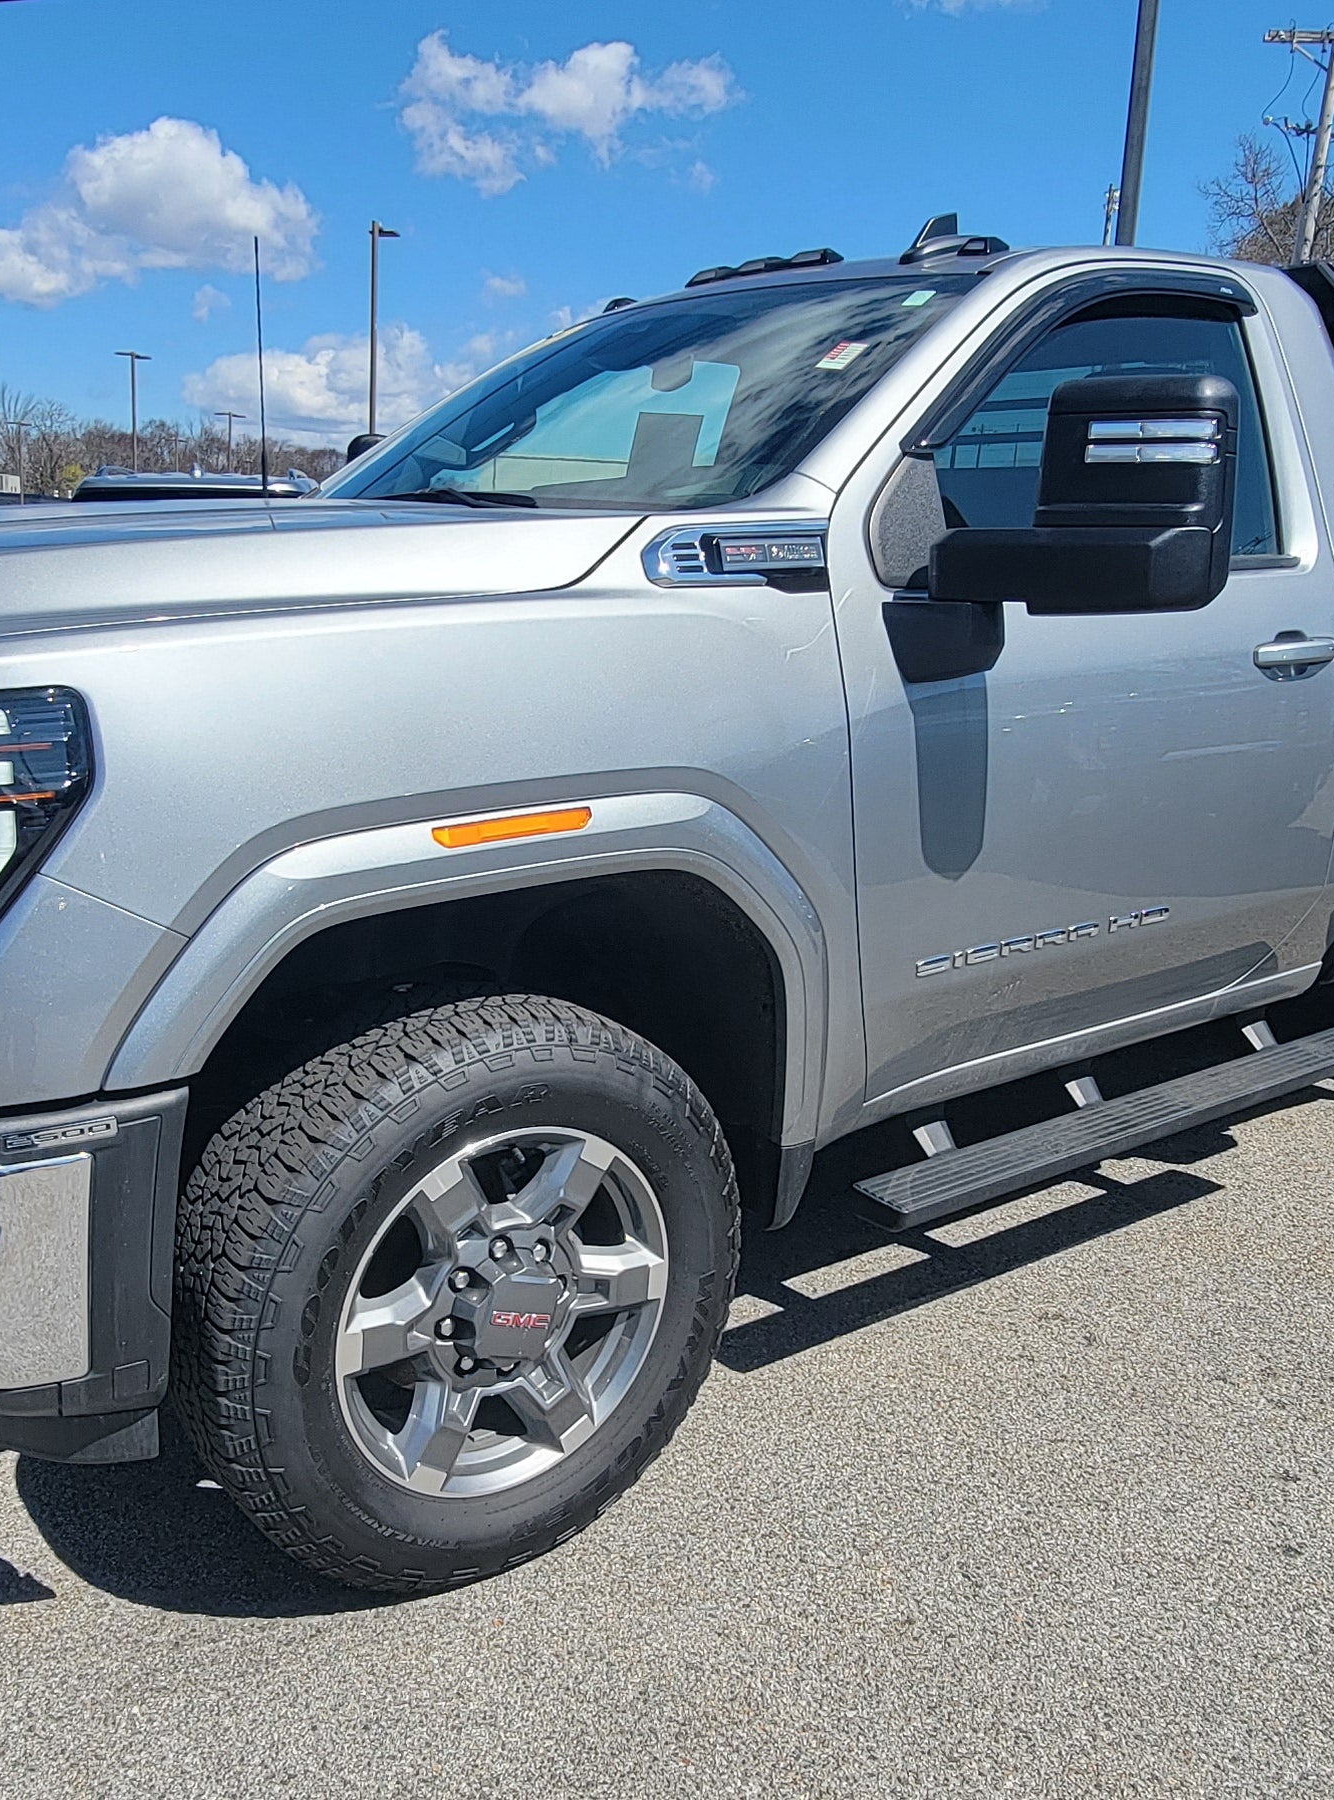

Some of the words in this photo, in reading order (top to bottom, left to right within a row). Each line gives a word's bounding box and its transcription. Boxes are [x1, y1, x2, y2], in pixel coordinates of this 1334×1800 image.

[915, 921, 1099, 978] SIERRA
[1108, 905, 1171, 934] HD
[3, 1119, 116, 1150] 2500
[490, 1310, 551, 1329] GMC
